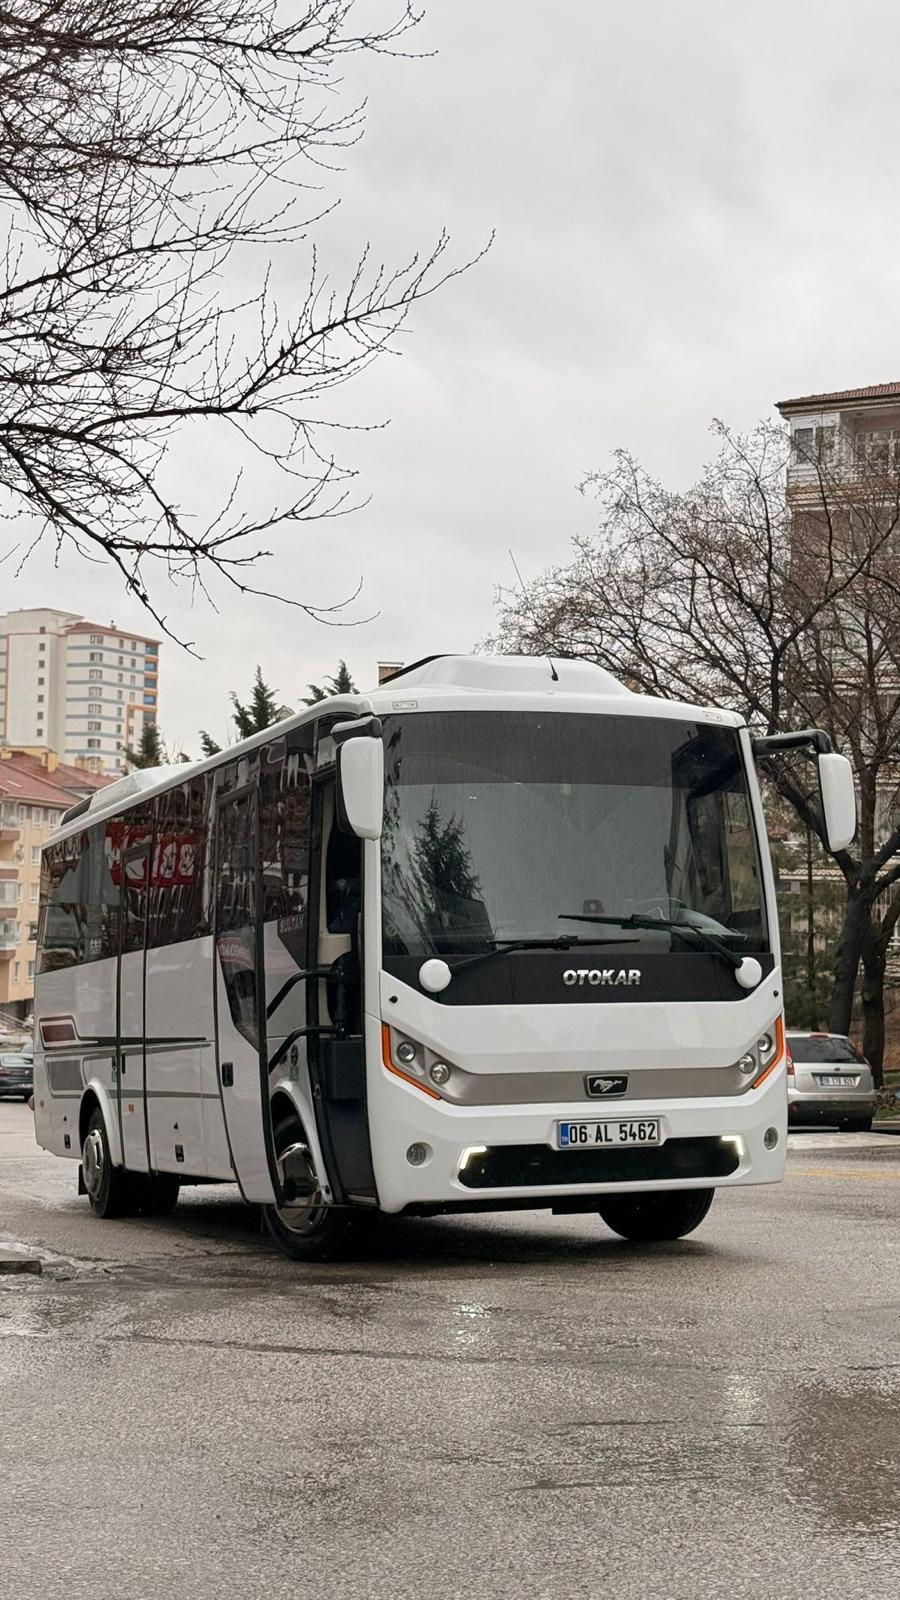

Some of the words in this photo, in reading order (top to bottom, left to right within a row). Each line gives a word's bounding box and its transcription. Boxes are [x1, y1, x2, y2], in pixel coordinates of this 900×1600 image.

[562, 969, 642, 986] OTOKAR
[569, 1125, 588, 1144] 06
[595, 1124, 613, 1143] AL
[619, 1122, 657, 1141] 5462
